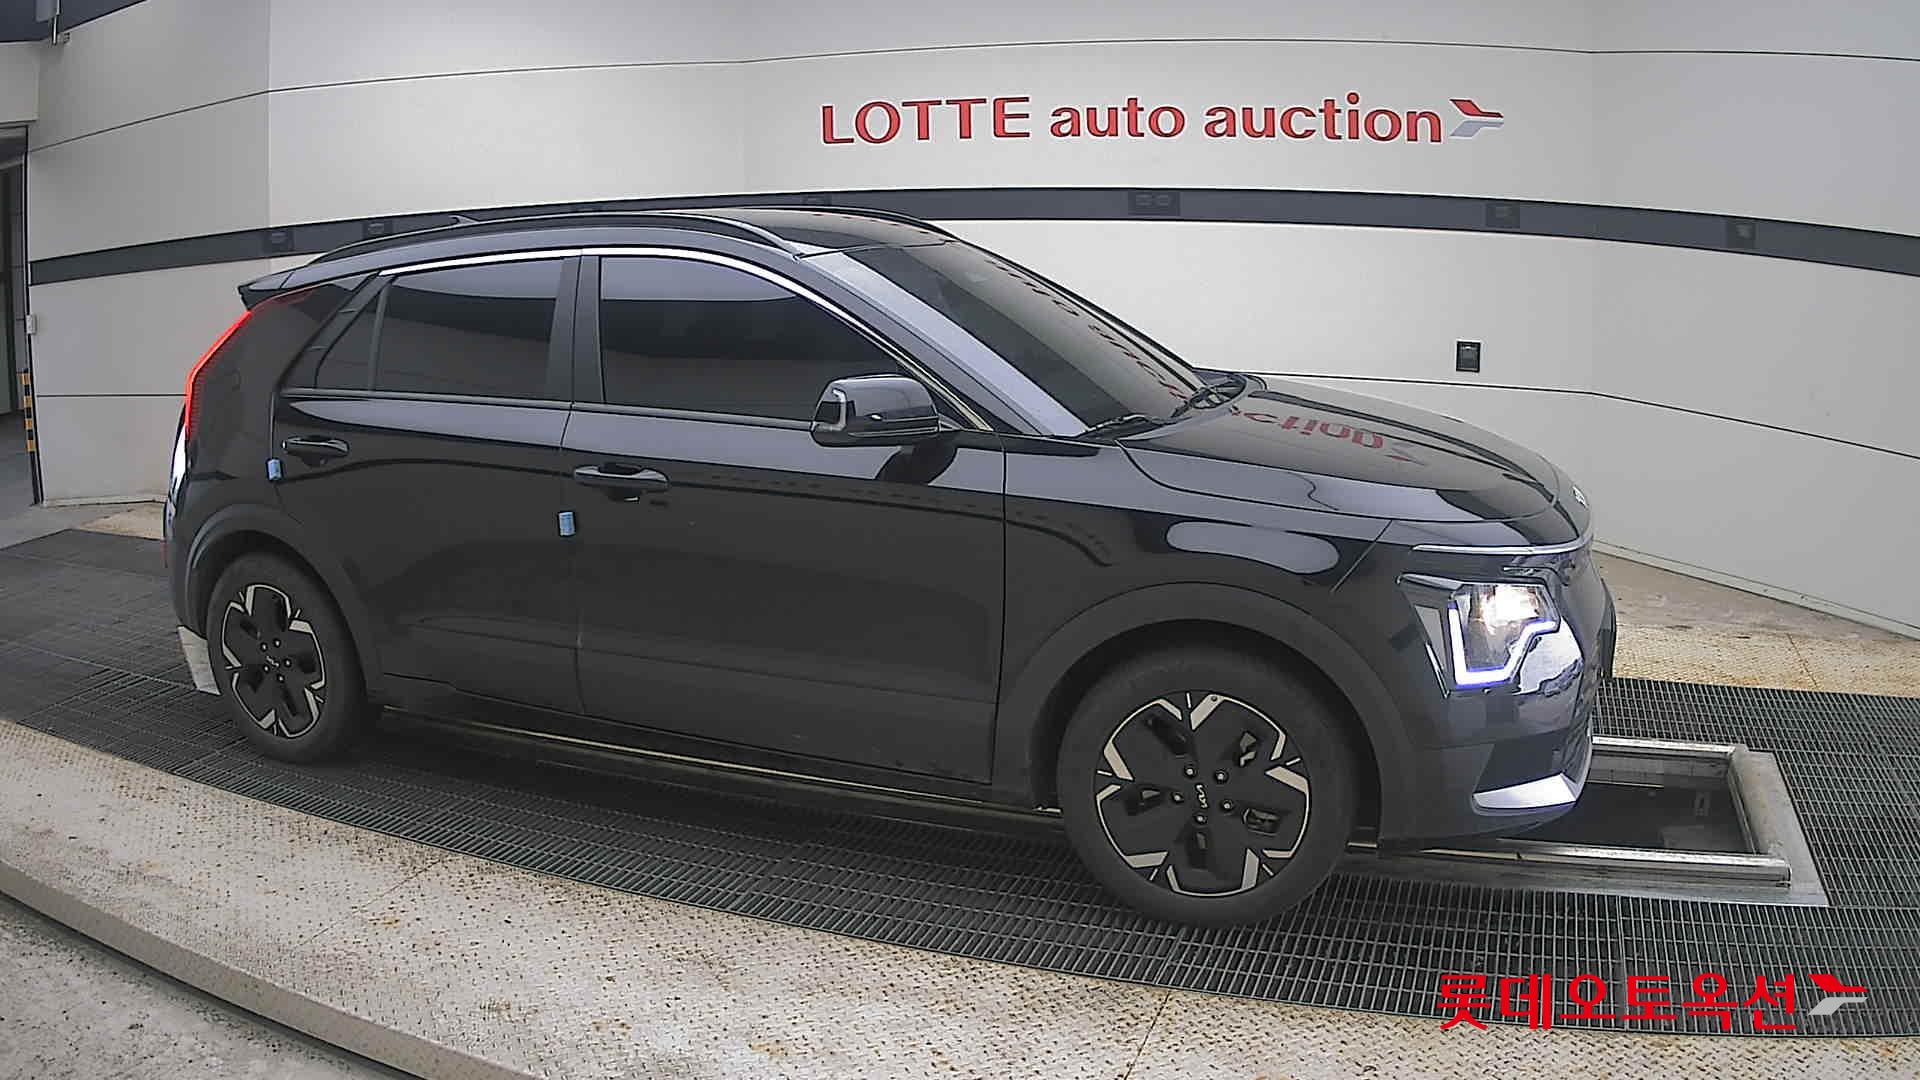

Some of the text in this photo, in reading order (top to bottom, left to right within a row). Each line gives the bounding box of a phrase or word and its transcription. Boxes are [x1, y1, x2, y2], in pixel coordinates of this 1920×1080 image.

[821, 92, 1443, 144] LOTTE auto auction
